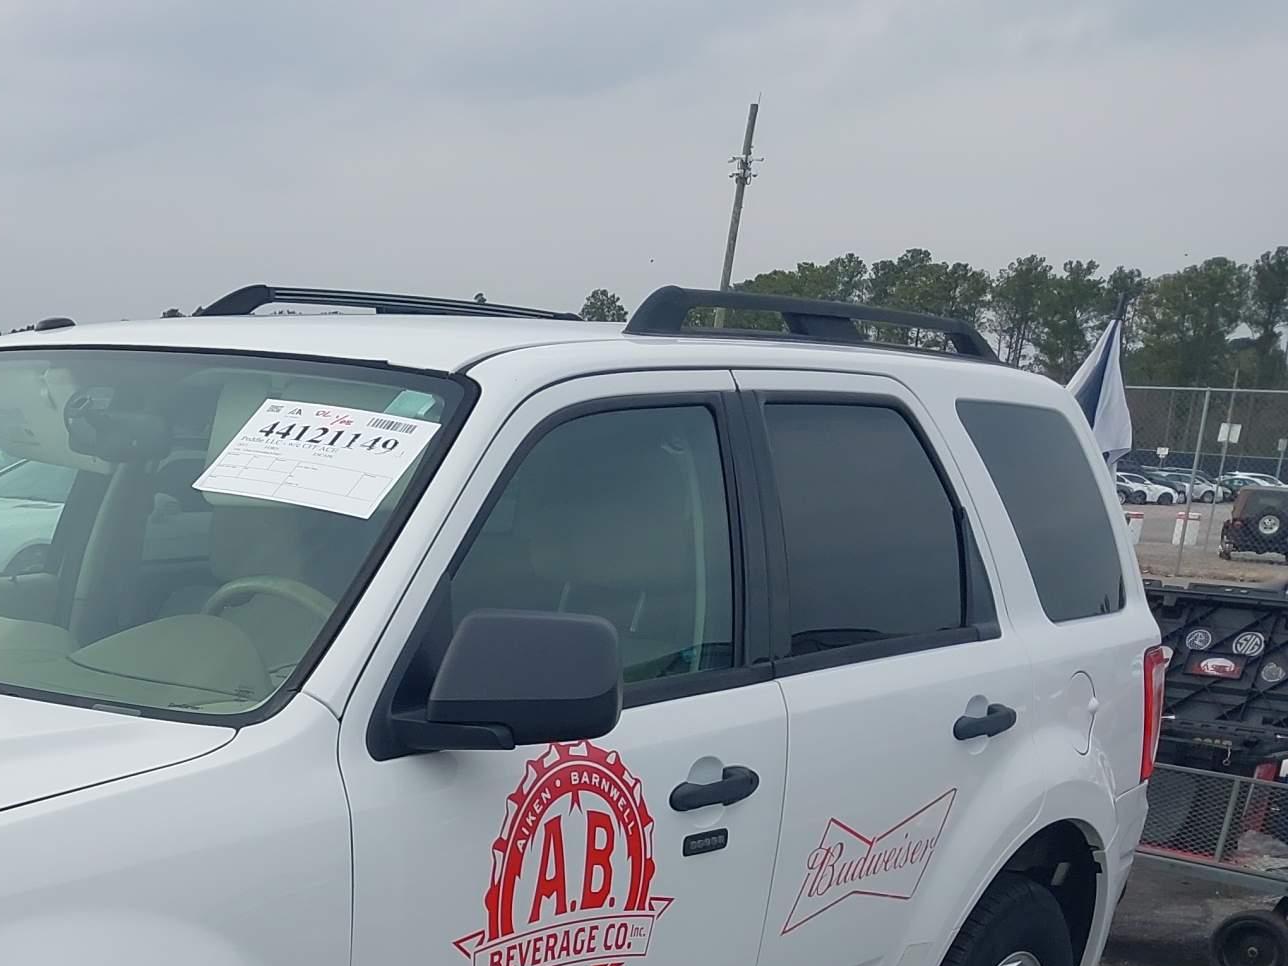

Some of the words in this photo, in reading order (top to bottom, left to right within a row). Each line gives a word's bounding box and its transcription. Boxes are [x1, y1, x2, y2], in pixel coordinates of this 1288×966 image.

[259, 420, 400, 455] 44121149
[516, 787, 552, 854] AIKEN
[570, 771, 635, 836] BARNWELL
[528, 809, 616, 924] A.B.
[807, 833, 936, 898] Budweiser
[602, 922, 632, 951] CO.
[630, 924, 647, 938] Inc.
